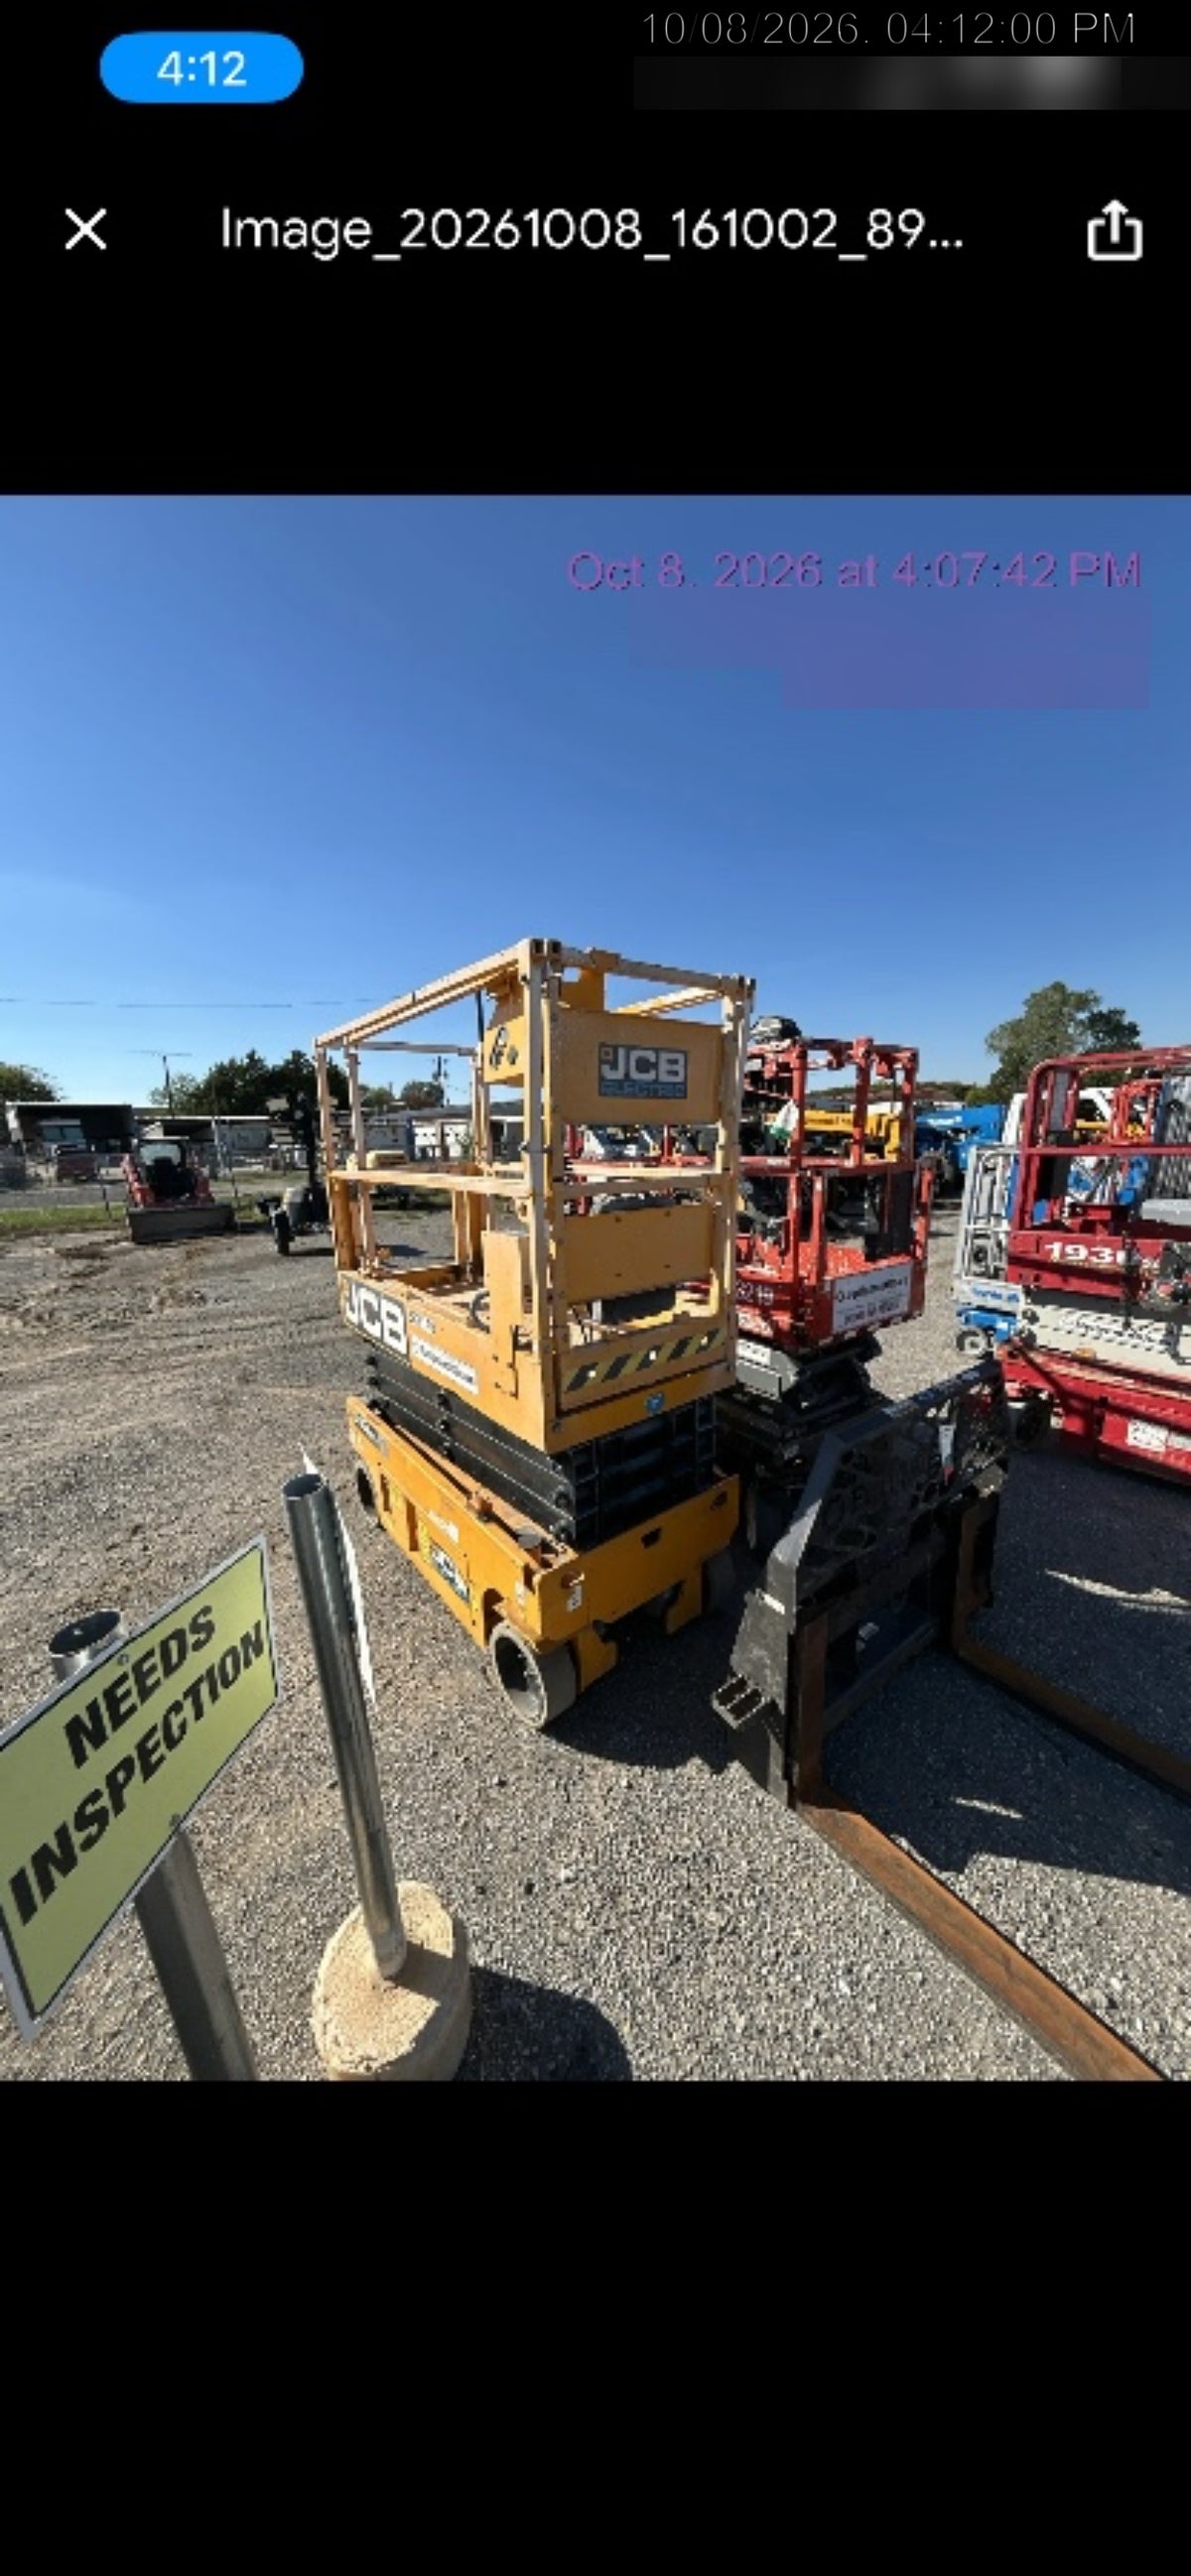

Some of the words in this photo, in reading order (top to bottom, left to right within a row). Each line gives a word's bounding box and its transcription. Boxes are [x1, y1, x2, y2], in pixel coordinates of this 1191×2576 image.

[600, 1046, 686, 1084] JCB
[345, 1281, 408, 1355] JCB
[64, 1606, 216, 1769] NEEDS
[8, 1619, 264, 1927] INSPECTION
